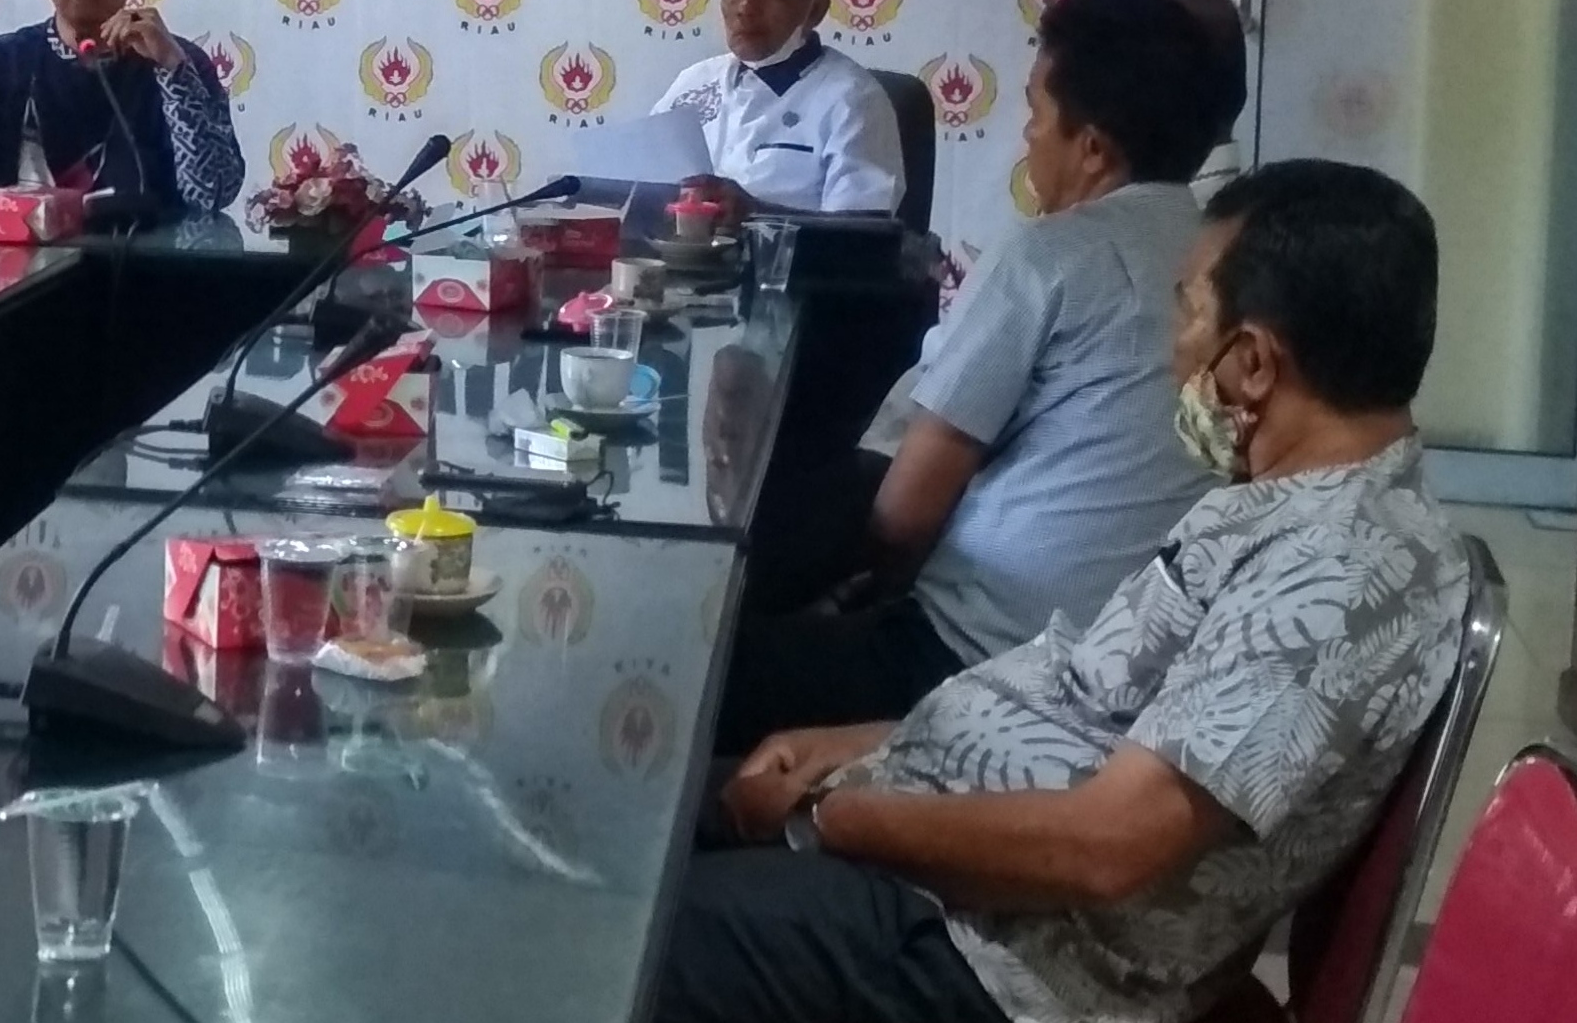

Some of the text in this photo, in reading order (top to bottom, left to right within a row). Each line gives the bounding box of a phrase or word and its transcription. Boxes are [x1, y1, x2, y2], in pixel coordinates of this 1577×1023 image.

[281, 15, 336, 30] RIAU
[460, 20, 516, 35] RIAU
[643, 25, 701, 41] RIAU
[832, 31, 892, 47] RIAU
[367, 107, 423, 122] RIAU
[548, 113, 605, 129] RIAU
[943, 128, 985, 142] IAU
